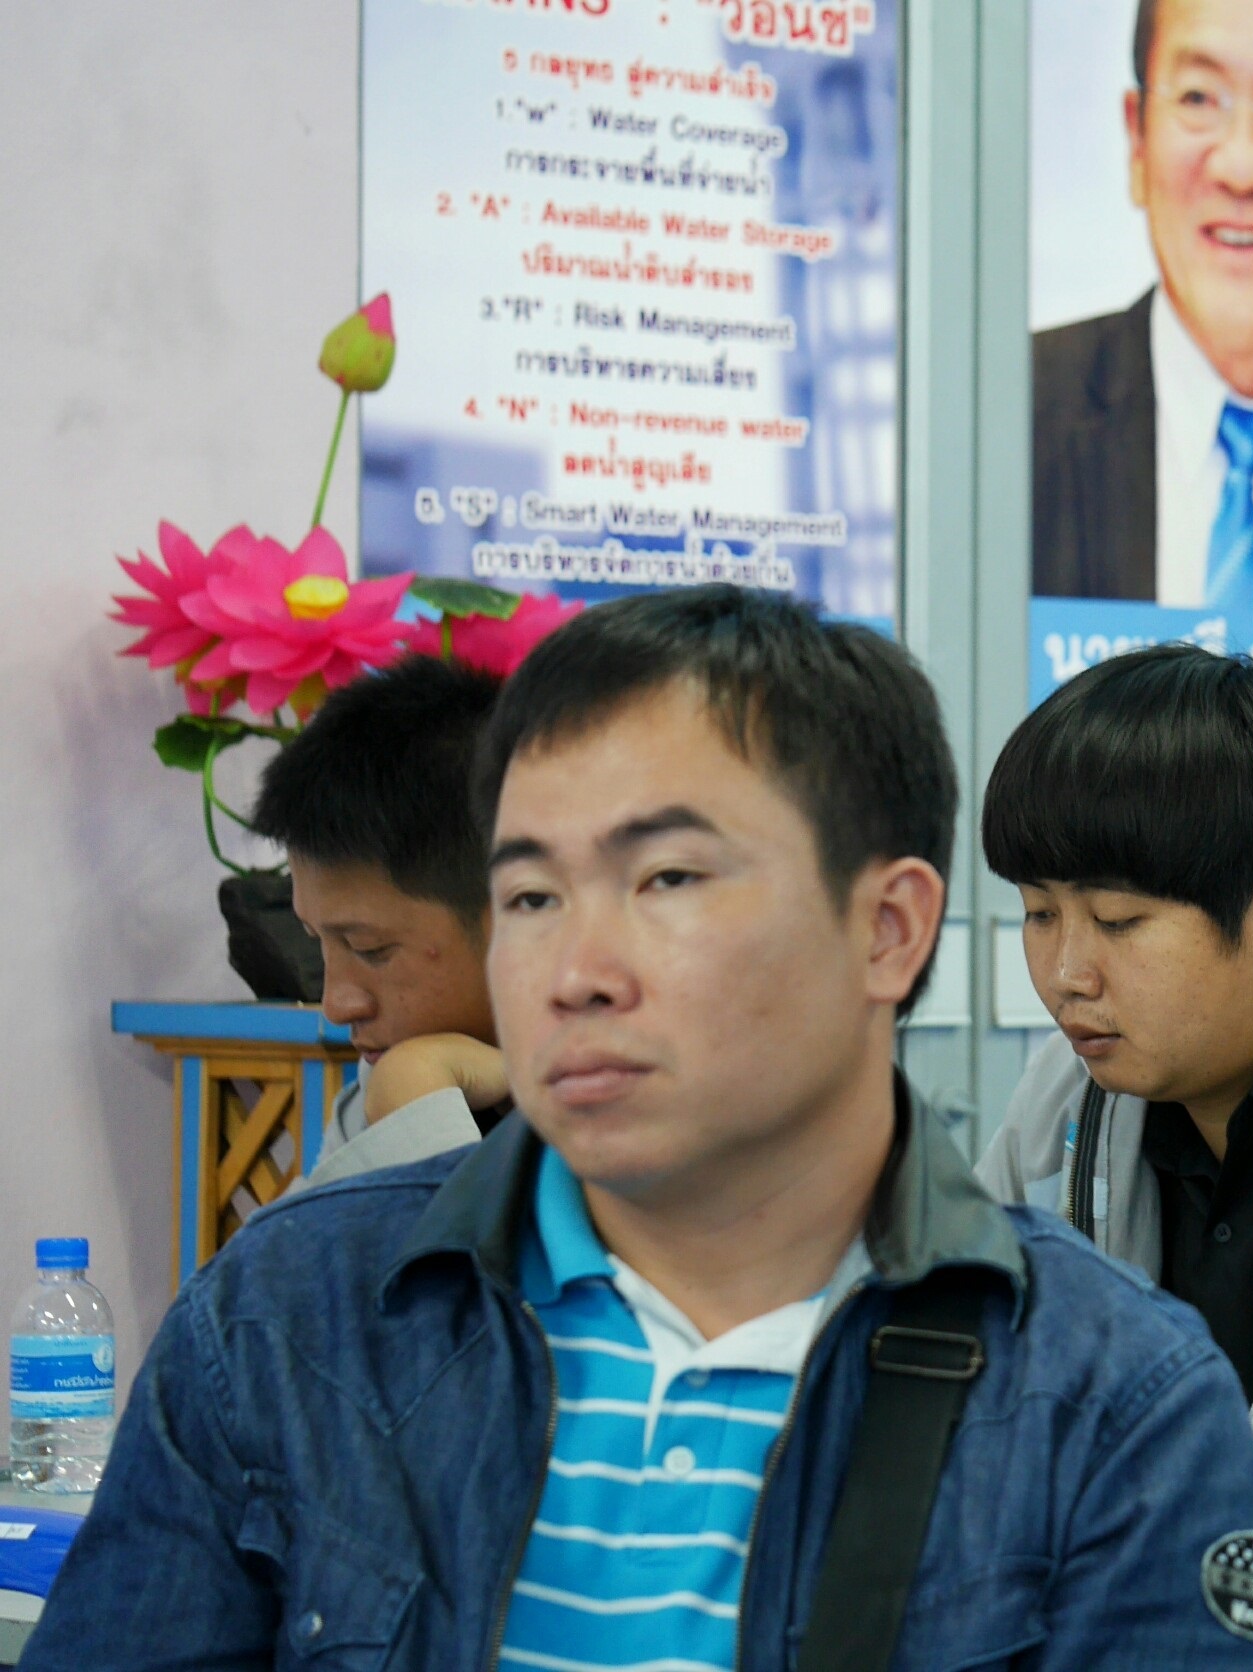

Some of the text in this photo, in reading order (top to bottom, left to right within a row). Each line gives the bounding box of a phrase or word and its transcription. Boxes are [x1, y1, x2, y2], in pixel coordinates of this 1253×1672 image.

[589, 105, 657, 134] Water
[670, 113, 781, 152] Coverage
[541, 199, 650, 232] Available
[661, 209, 730, 240] Water
[741, 218, 833, 254] Storage
[574, 302, 626, 330] Risk
[639, 309, 792, 343] Management
[570, 402, 729, 435] Non-revenue
[741, 417, 806, 441] water
[526, 498, 598, 523] Smart
[609, 503, 678, 527] Water
[692, 509, 843, 538] Management
